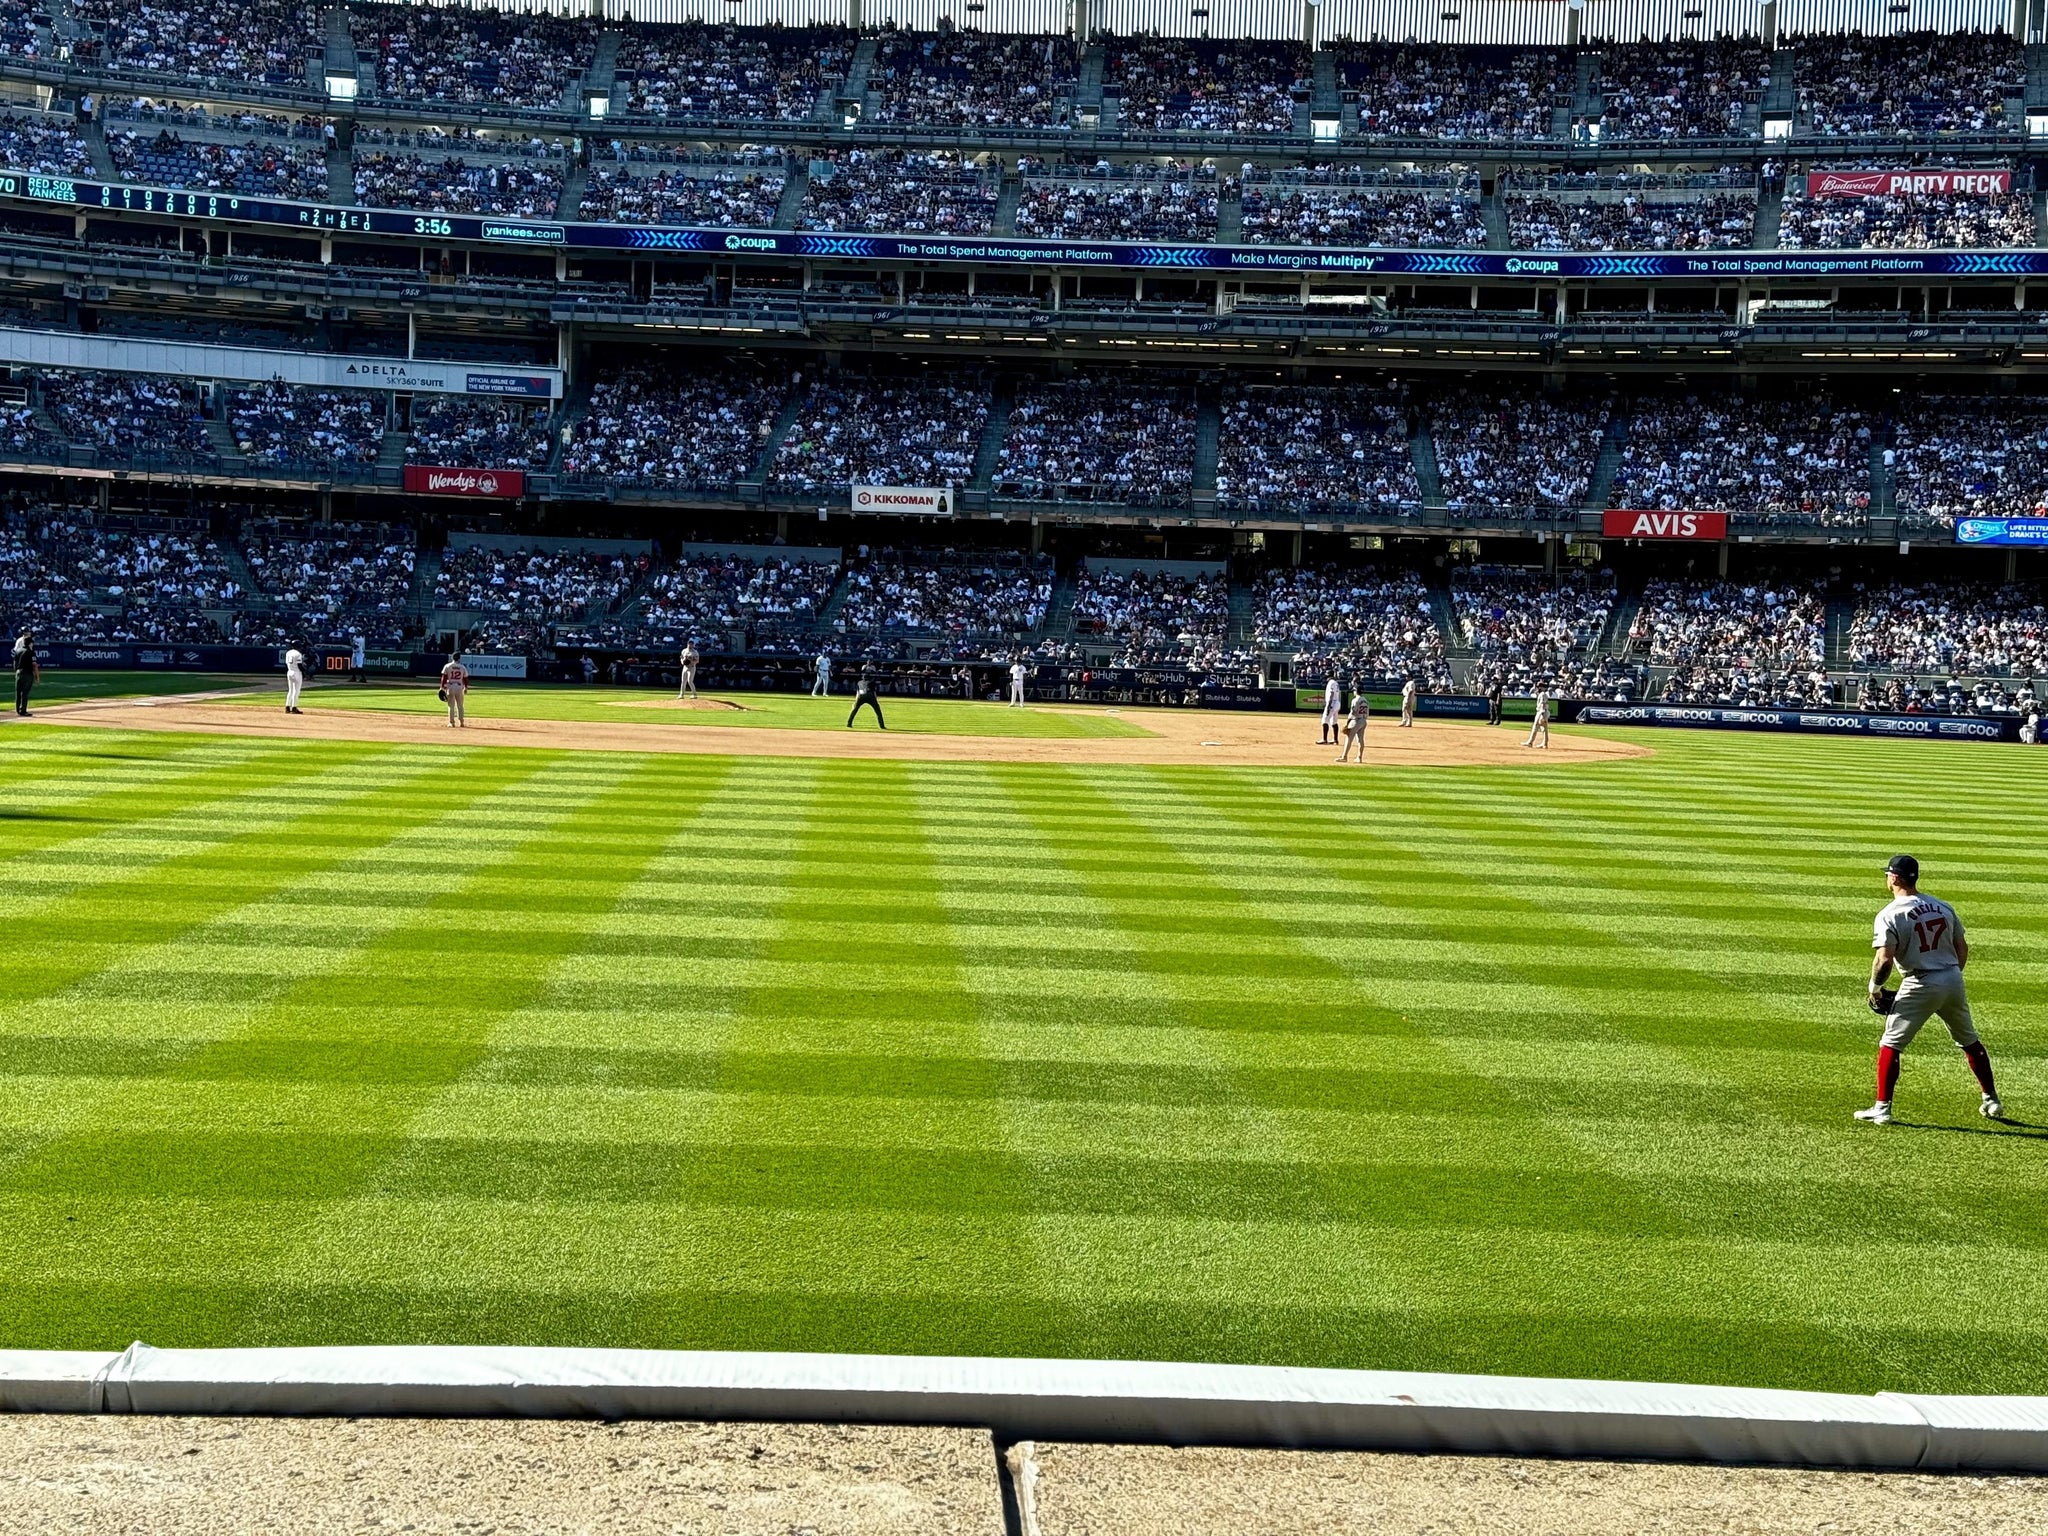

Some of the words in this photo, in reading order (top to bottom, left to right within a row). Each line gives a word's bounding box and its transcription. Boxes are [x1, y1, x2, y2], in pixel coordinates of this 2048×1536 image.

[1825, 178, 1876, 190] Budweiser
[1890, 175, 1948, 194] PARTY
[1953, 175, 2003, 194] DECK
[28, 177, 50, 189] RED
[53, 180, 74, 192] SOX
[102, 186, 109, 196] 0
[123, 188, 130, 198] 0
[145, 190, 152, 200] 0
[167, 193, 174, 203] 2
[188, 195, 195, 205] 0
[209, 197, 217, 207] 0
[231, 199, 238, 209] 0
[28, 187, 76, 201] YANKEES
[102, 196, 109, 206] 0
[125, 199, 130, 209] 1
[145, 201, 152, 211] 3
[166, 203, 174, 213] 0
[188, 205, 195, 215] 0
[209, 207, 216, 217] 0
[300, 211, 308, 222] R
[326, 214, 334, 224] H
[351, 216, 358, 226] E
[313, 209, 319, 218] 2
[341, 211, 347, 220] 7
[340, 220, 346, 229] 8
[363, 222, 370, 231] 0
[414, 217, 451, 235] 3:56
[486, 227, 561, 239] yankees.com
[741, 237, 776, 251] coupa
[897, 244, 917, 254] The
[920, 244, 947, 255] Total
[949, 246, 985, 258] Spend
[987, 247, 1063, 260] Management
[1065, 249, 1113, 261] Platform
[1231, 253, 1265, 264] Make
[1268, 254, 1318, 268] Margins
[1687, 260, 1708, 270] The
[1711, 260, 1741, 270] Total
[1744, 260, 1782, 272] Spend
[1785, 259, 1868, 272] Management
[1871, 259, 1923, 270] Platform
[1522, 260, 1559, 274] coupa
[1199, 322, 1217, 331] 1977
[1540, 332, 1559, 340] 1996
[1719, 330, 1739, 338] 1998
[1908, 329, 1929, 338] 1999
[362, 365, 406, 376] DELTA
[420, 379, 444, 387] SUITE
[429, 472, 475, 491] Wendy's
[874, 495, 933, 505] KIKKOMAN
[1631, 514, 1697, 536] AVIS
[76, 649, 119, 660] Spectrum
[363, 658, 379, 666] land
[380, 657, 408, 669] Spring
[451, 671, 461, 679] 12
[1236, 695, 1261, 703] StubHub
[1682, 710, 1715, 720] COOL
[1749, 713, 1783, 724] COOL
[1828, 717, 1862, 728] COOL
[1897, 719, 1933, 732] COOL
[1908, 903, 1942, 920] O'NEILL
[1914, 917, 1947, 953] 17
